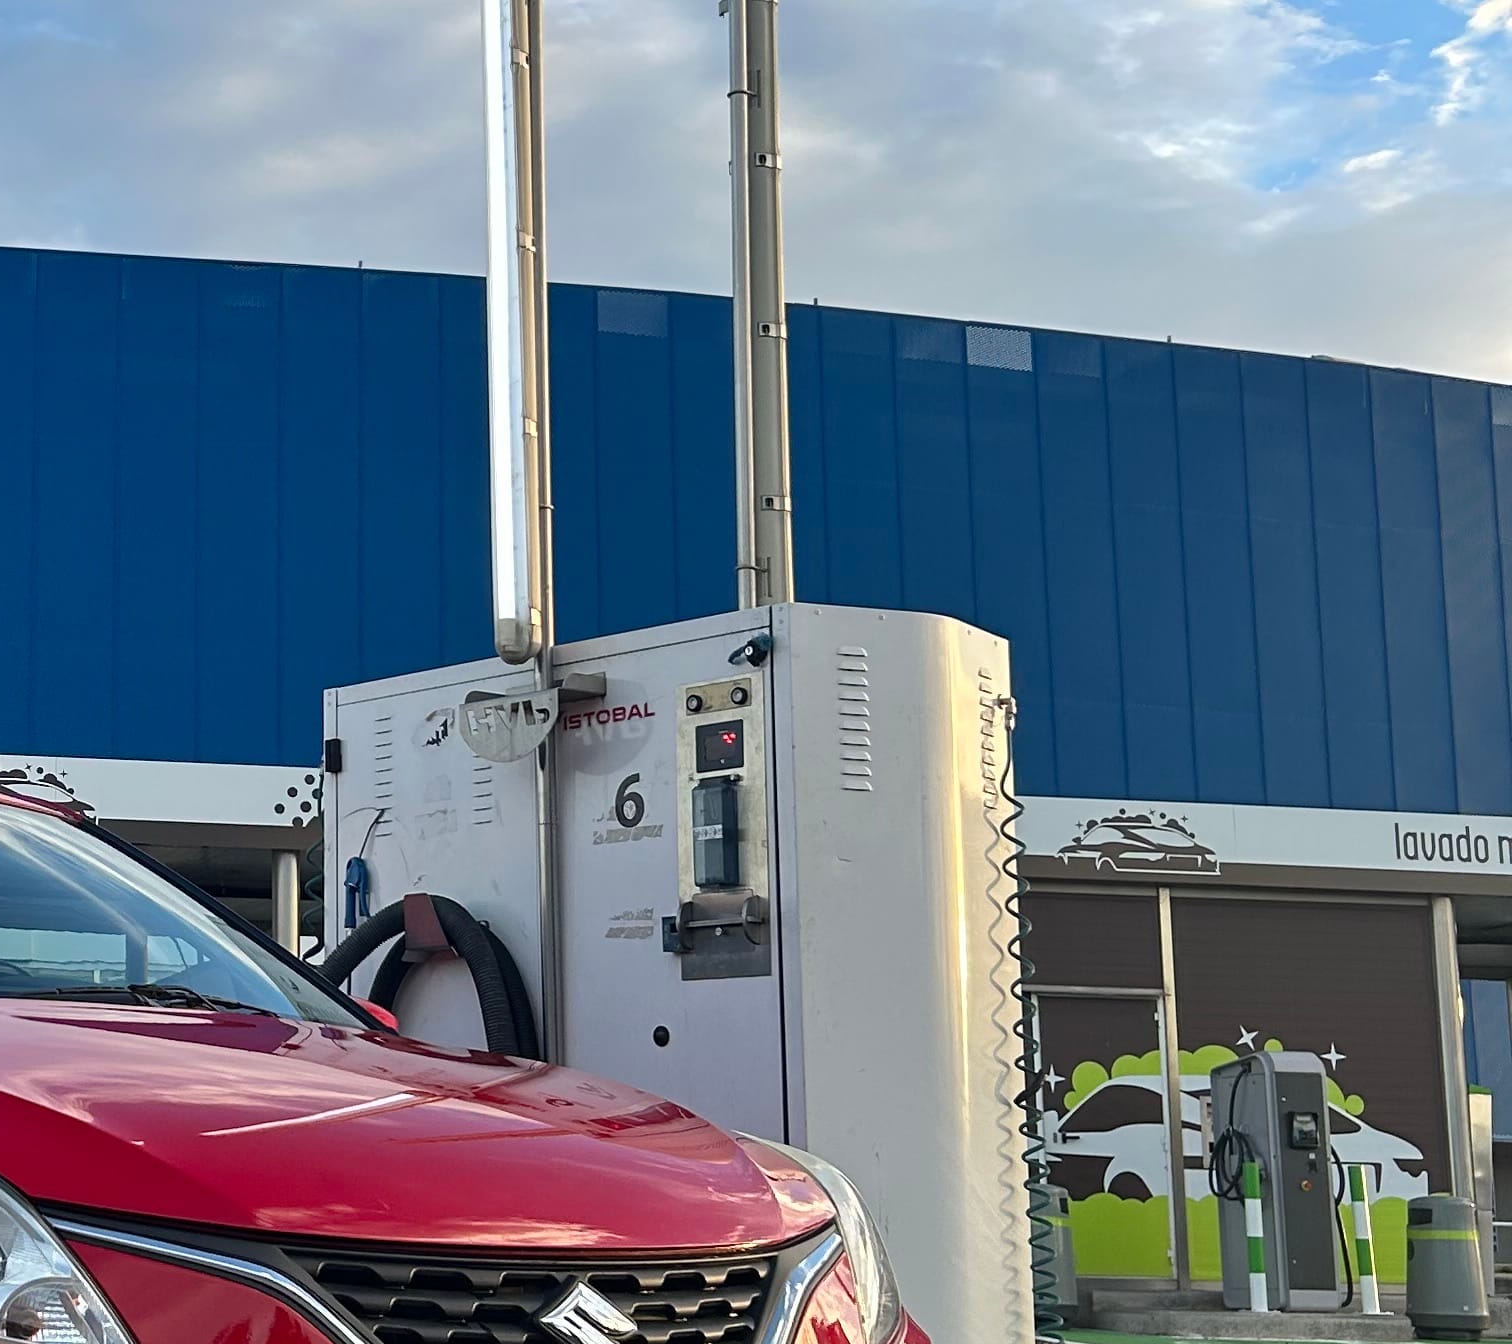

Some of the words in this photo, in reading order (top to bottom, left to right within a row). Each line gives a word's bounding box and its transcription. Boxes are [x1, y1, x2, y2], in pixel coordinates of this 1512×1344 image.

[562, 702, 656, 731] ISTOBAL
[615, 772, 645, 828] 6
[1394, 822, 1490, 864] lavado
